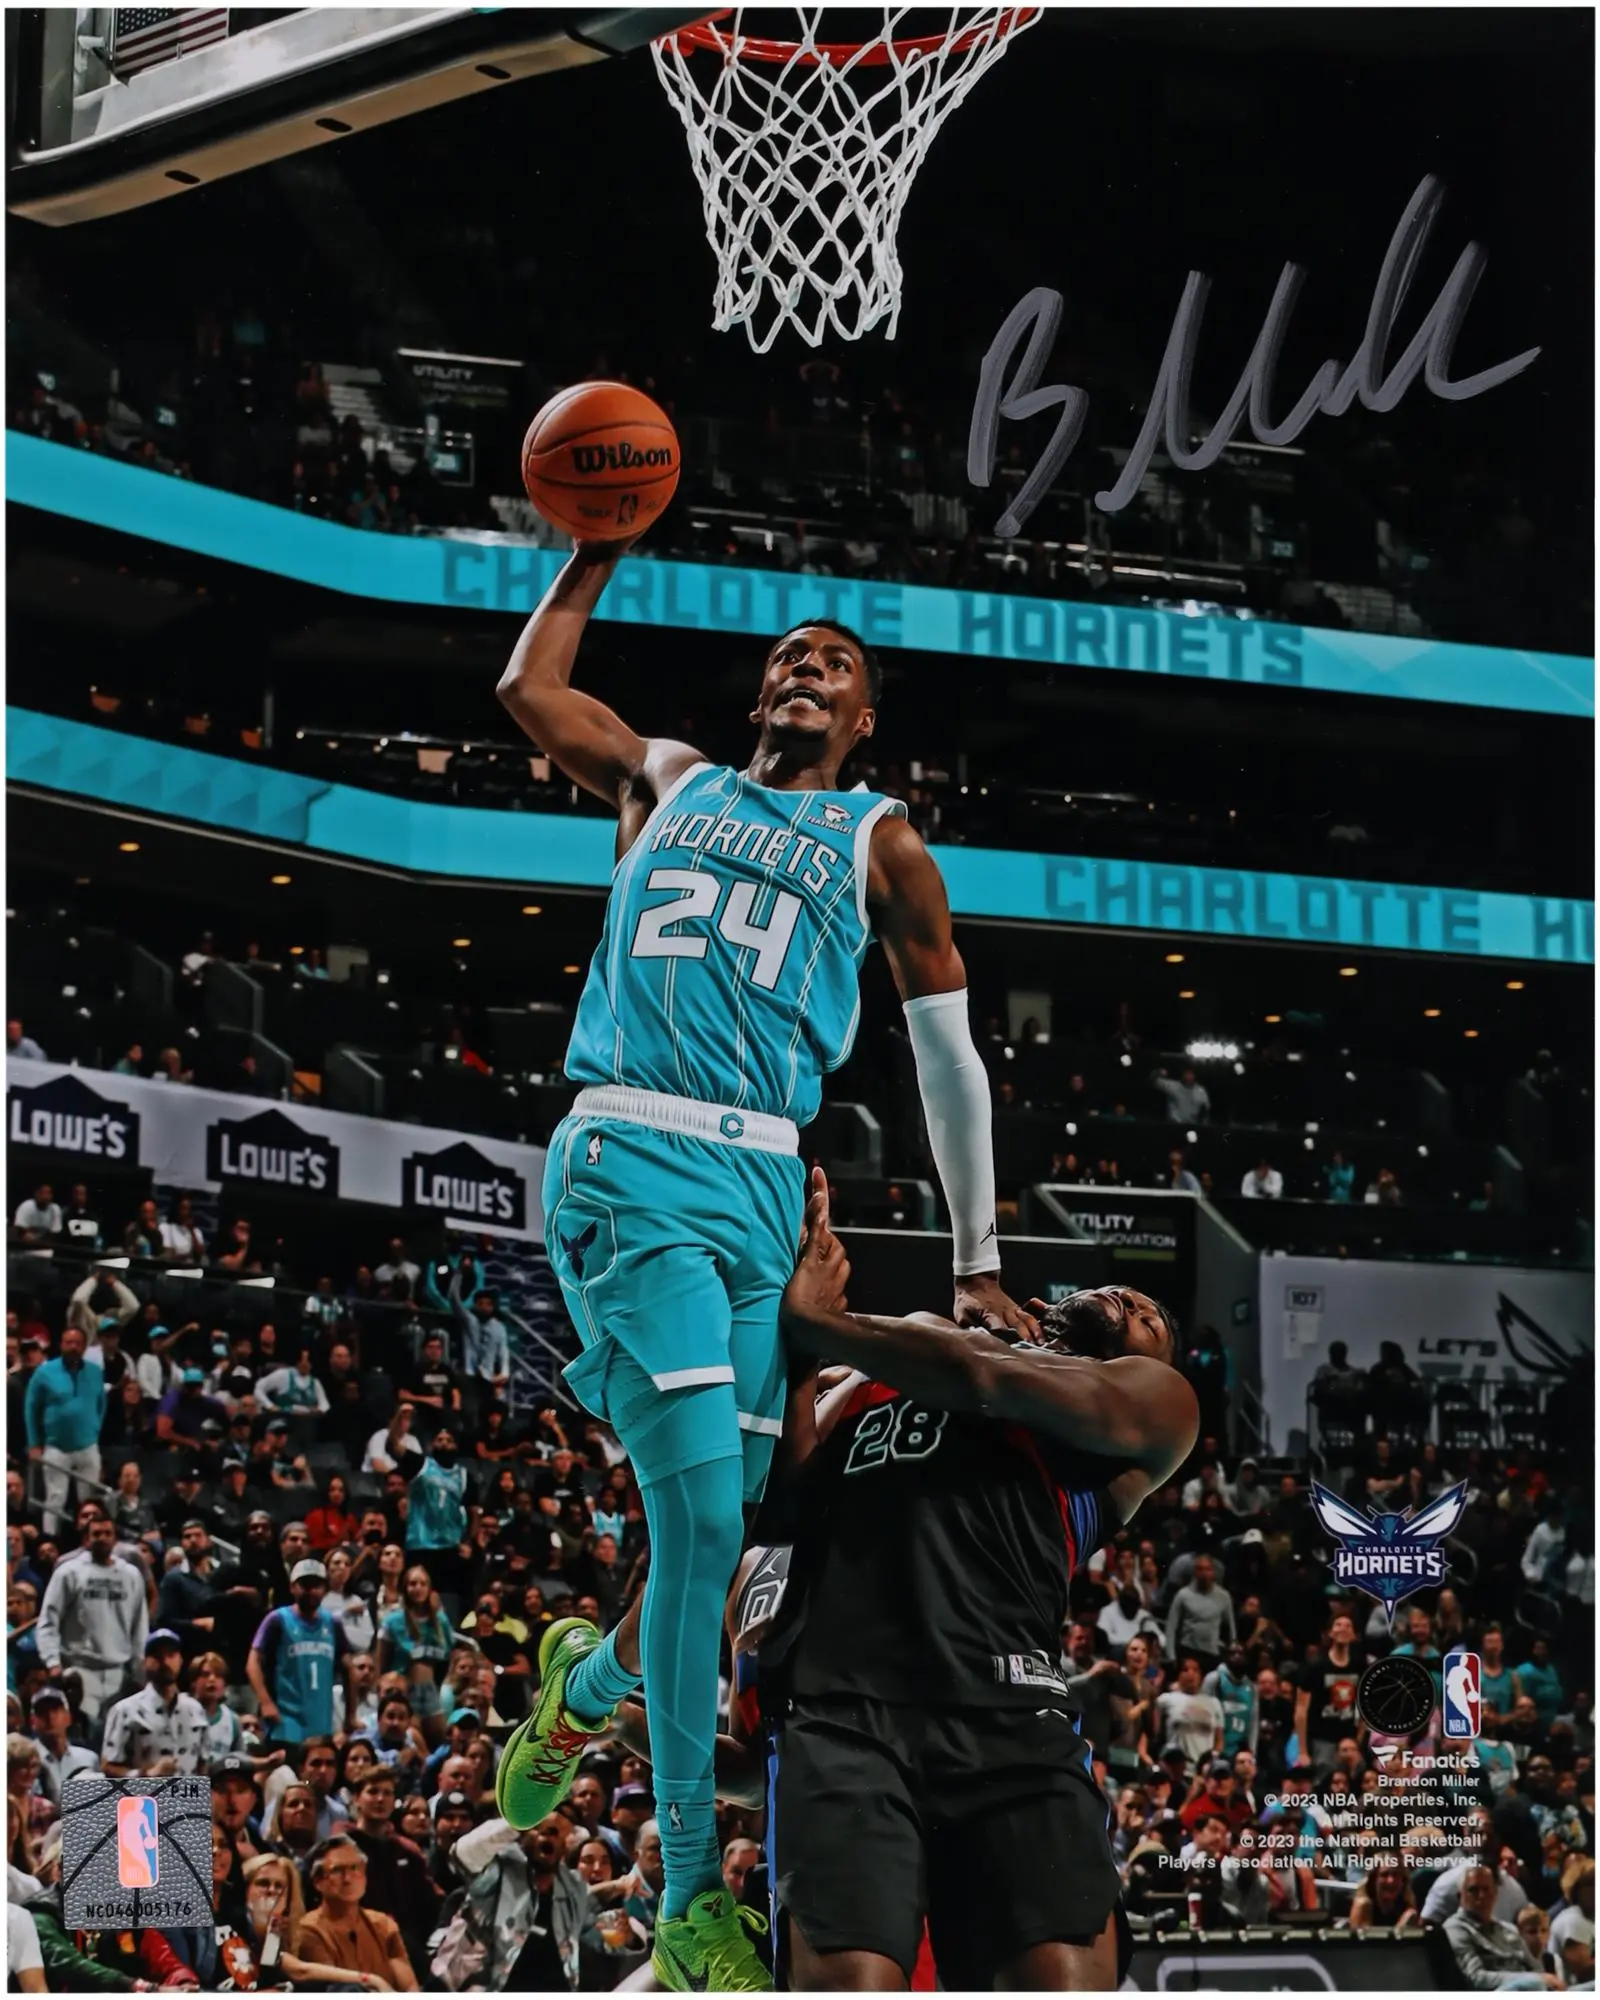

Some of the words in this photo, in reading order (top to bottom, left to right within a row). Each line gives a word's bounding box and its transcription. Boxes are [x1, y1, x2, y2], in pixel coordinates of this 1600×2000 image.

[572, 442, 671, 474] Wilson
[442, 542, 904, 646] CHRLOTTE
[951, 589, 1304, 686] HORNETS
[649, 814, 838, 896] HORNETS
[630, 868, 804, 992] 24
[1040, 855, 1482, 953] CHARLOTTE
[10, 1099, 127, 1158] LOWE'S
[221, 1132, 328, 1189] LOWE'S
[414, 1165, 514, 1219] LOWE'S
[843, 1399, 949, 1474] 28
[309, 1660, 319, 1690] 1
